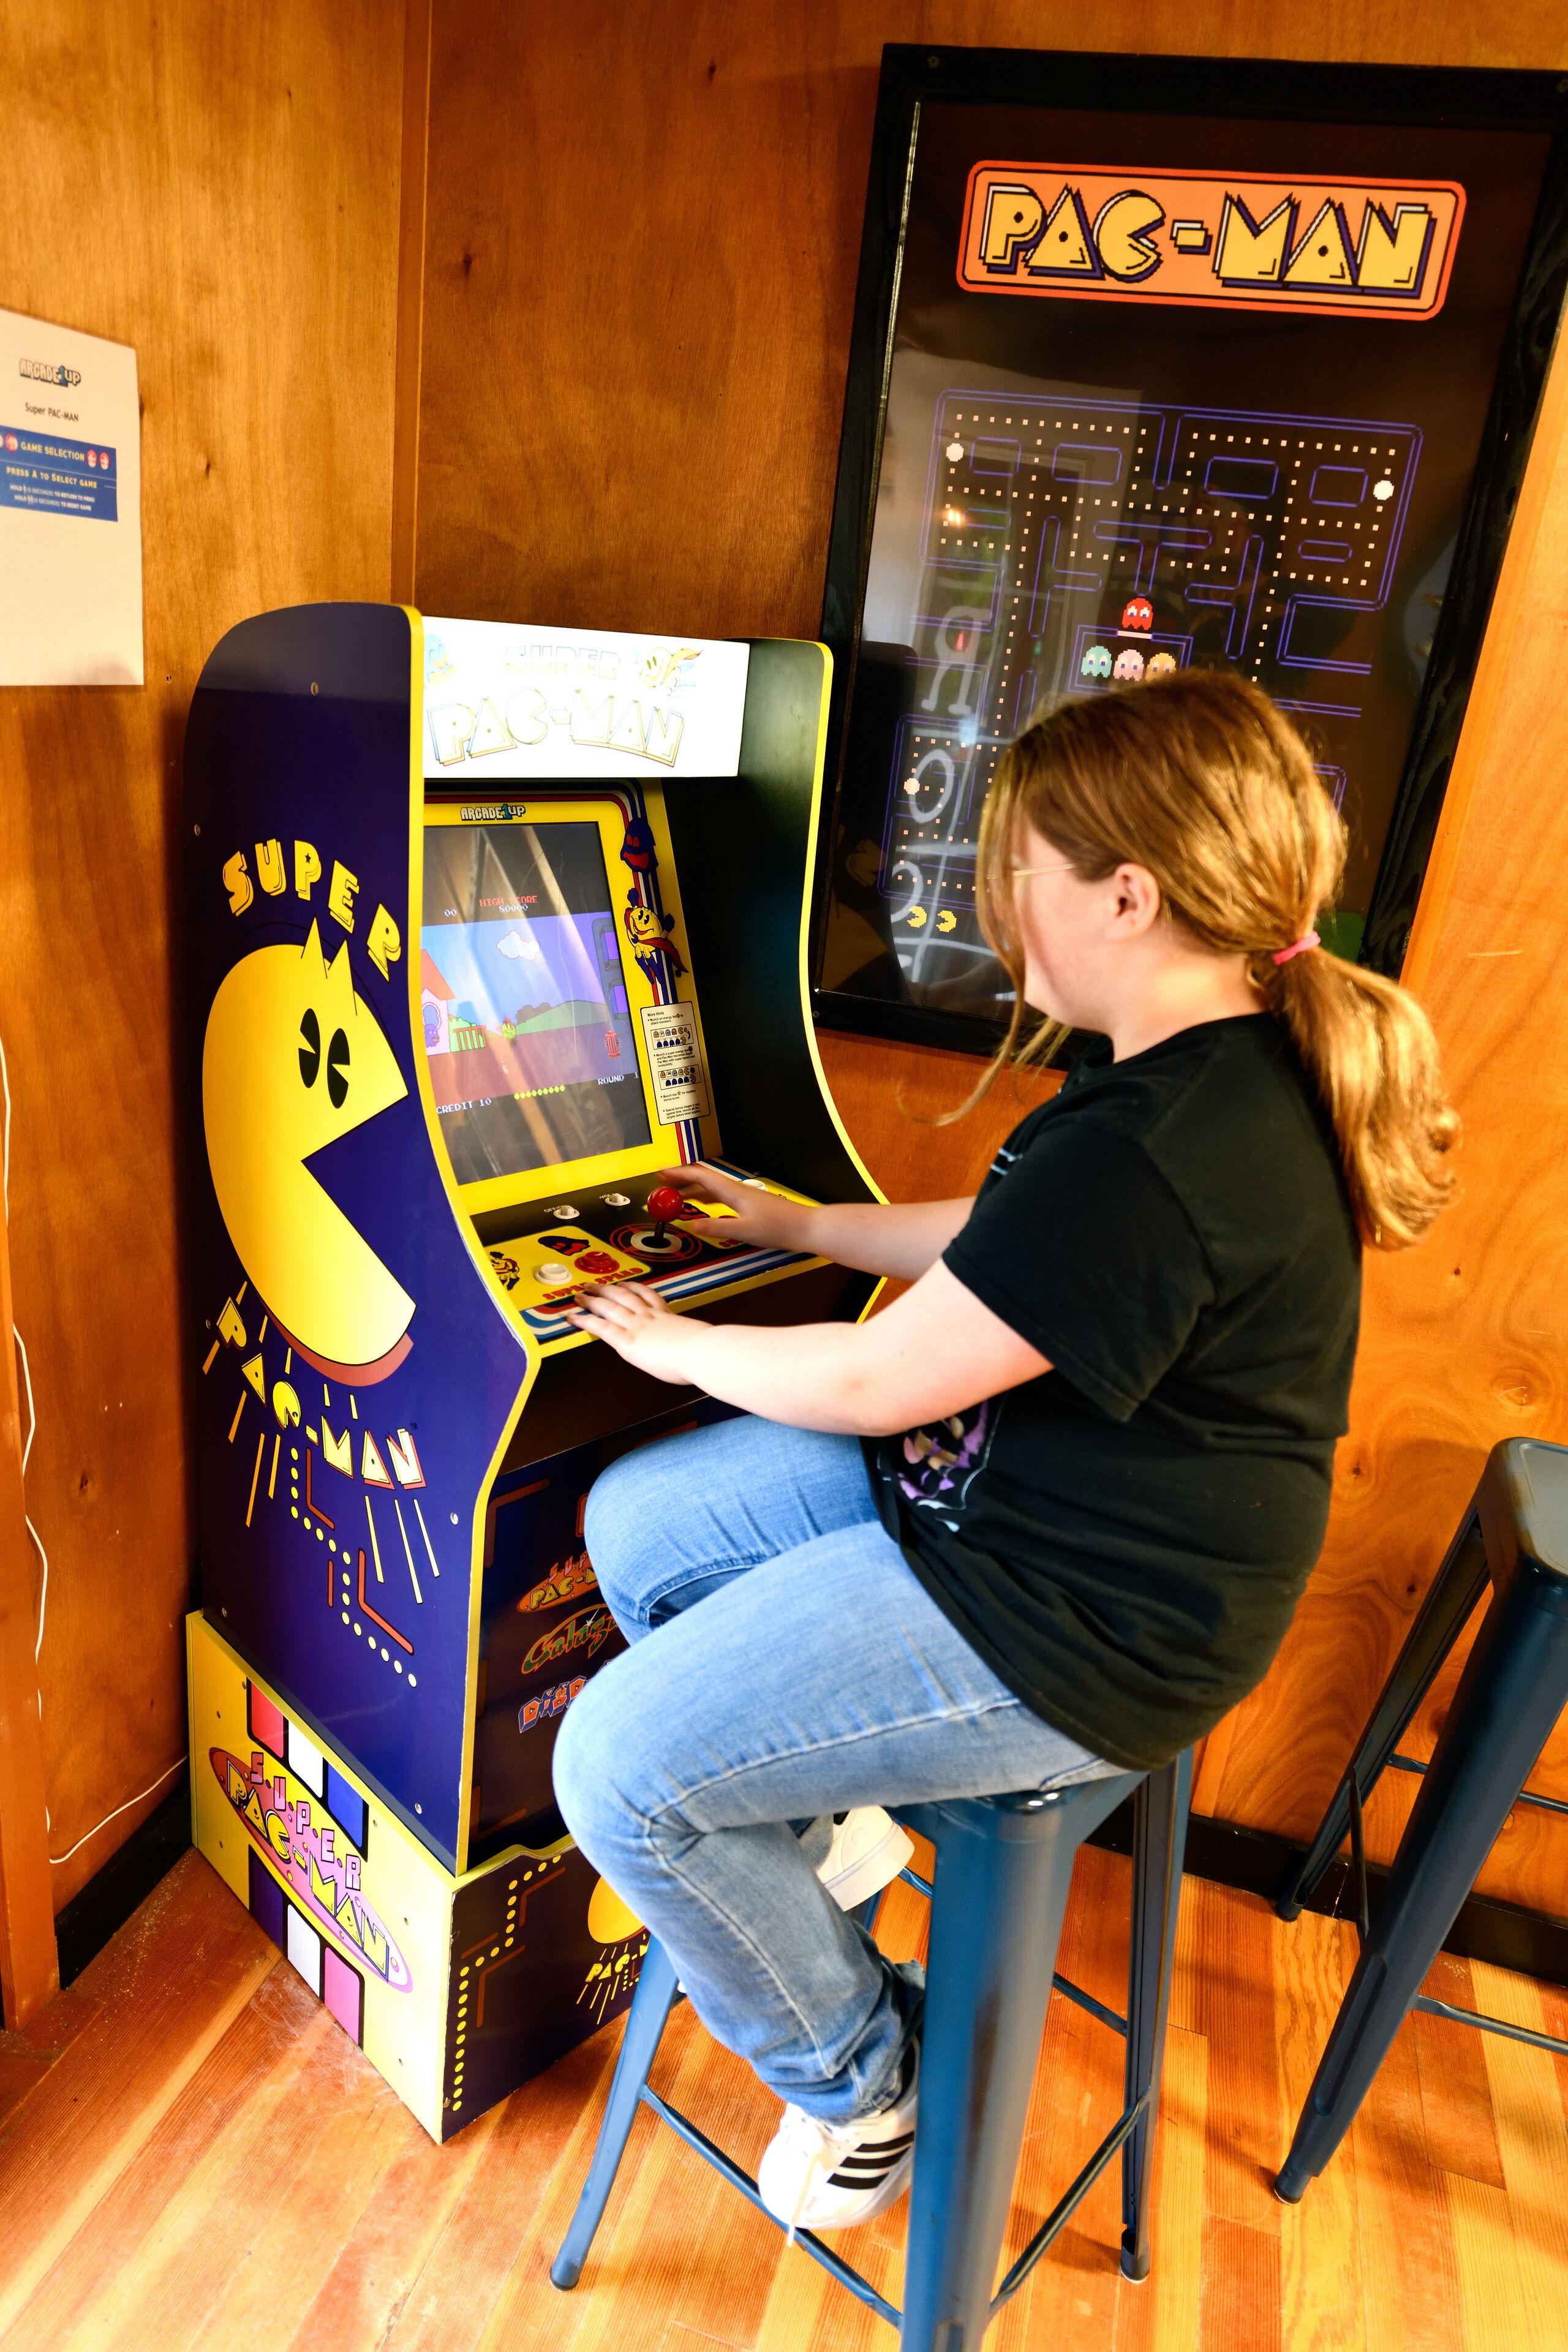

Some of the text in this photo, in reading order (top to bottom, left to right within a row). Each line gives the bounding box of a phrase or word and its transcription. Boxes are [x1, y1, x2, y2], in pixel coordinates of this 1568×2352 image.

[980, 183, 1437, 299] PAC-MAN
[25, 402, 79, 422] Super PAC-MAN
[21, 442, 85, 461] GAME SELECTION
[6, 466, 29, 477] PRESS
[80, 480, 97, 489] GAME
[505, 645, 620, 680] SUPER
[426, 686, 684, 767] PAC-MAN
[222, 838, 402, 982] SUPER
[444, 908, 457, 917] 00
[479, 895, 538, 907] HIGH SCORE
[597, 1074, 624, 1085] ROUND
[436, 1098, 491, 1115] CREDIT 10
[595, 1268, 644, 1284] SPEED
[216, 1296, 427, 1490] PAC-MAN
[548, 1550, 589, 1584] SUP
[530, 1567, 598, 1610] PAC-
[250, 1752, 361, 1891] SUPER
[226, 1759, 390, 1983] PAC-MAN
[585, 1944, 650, 1982] PAC-
